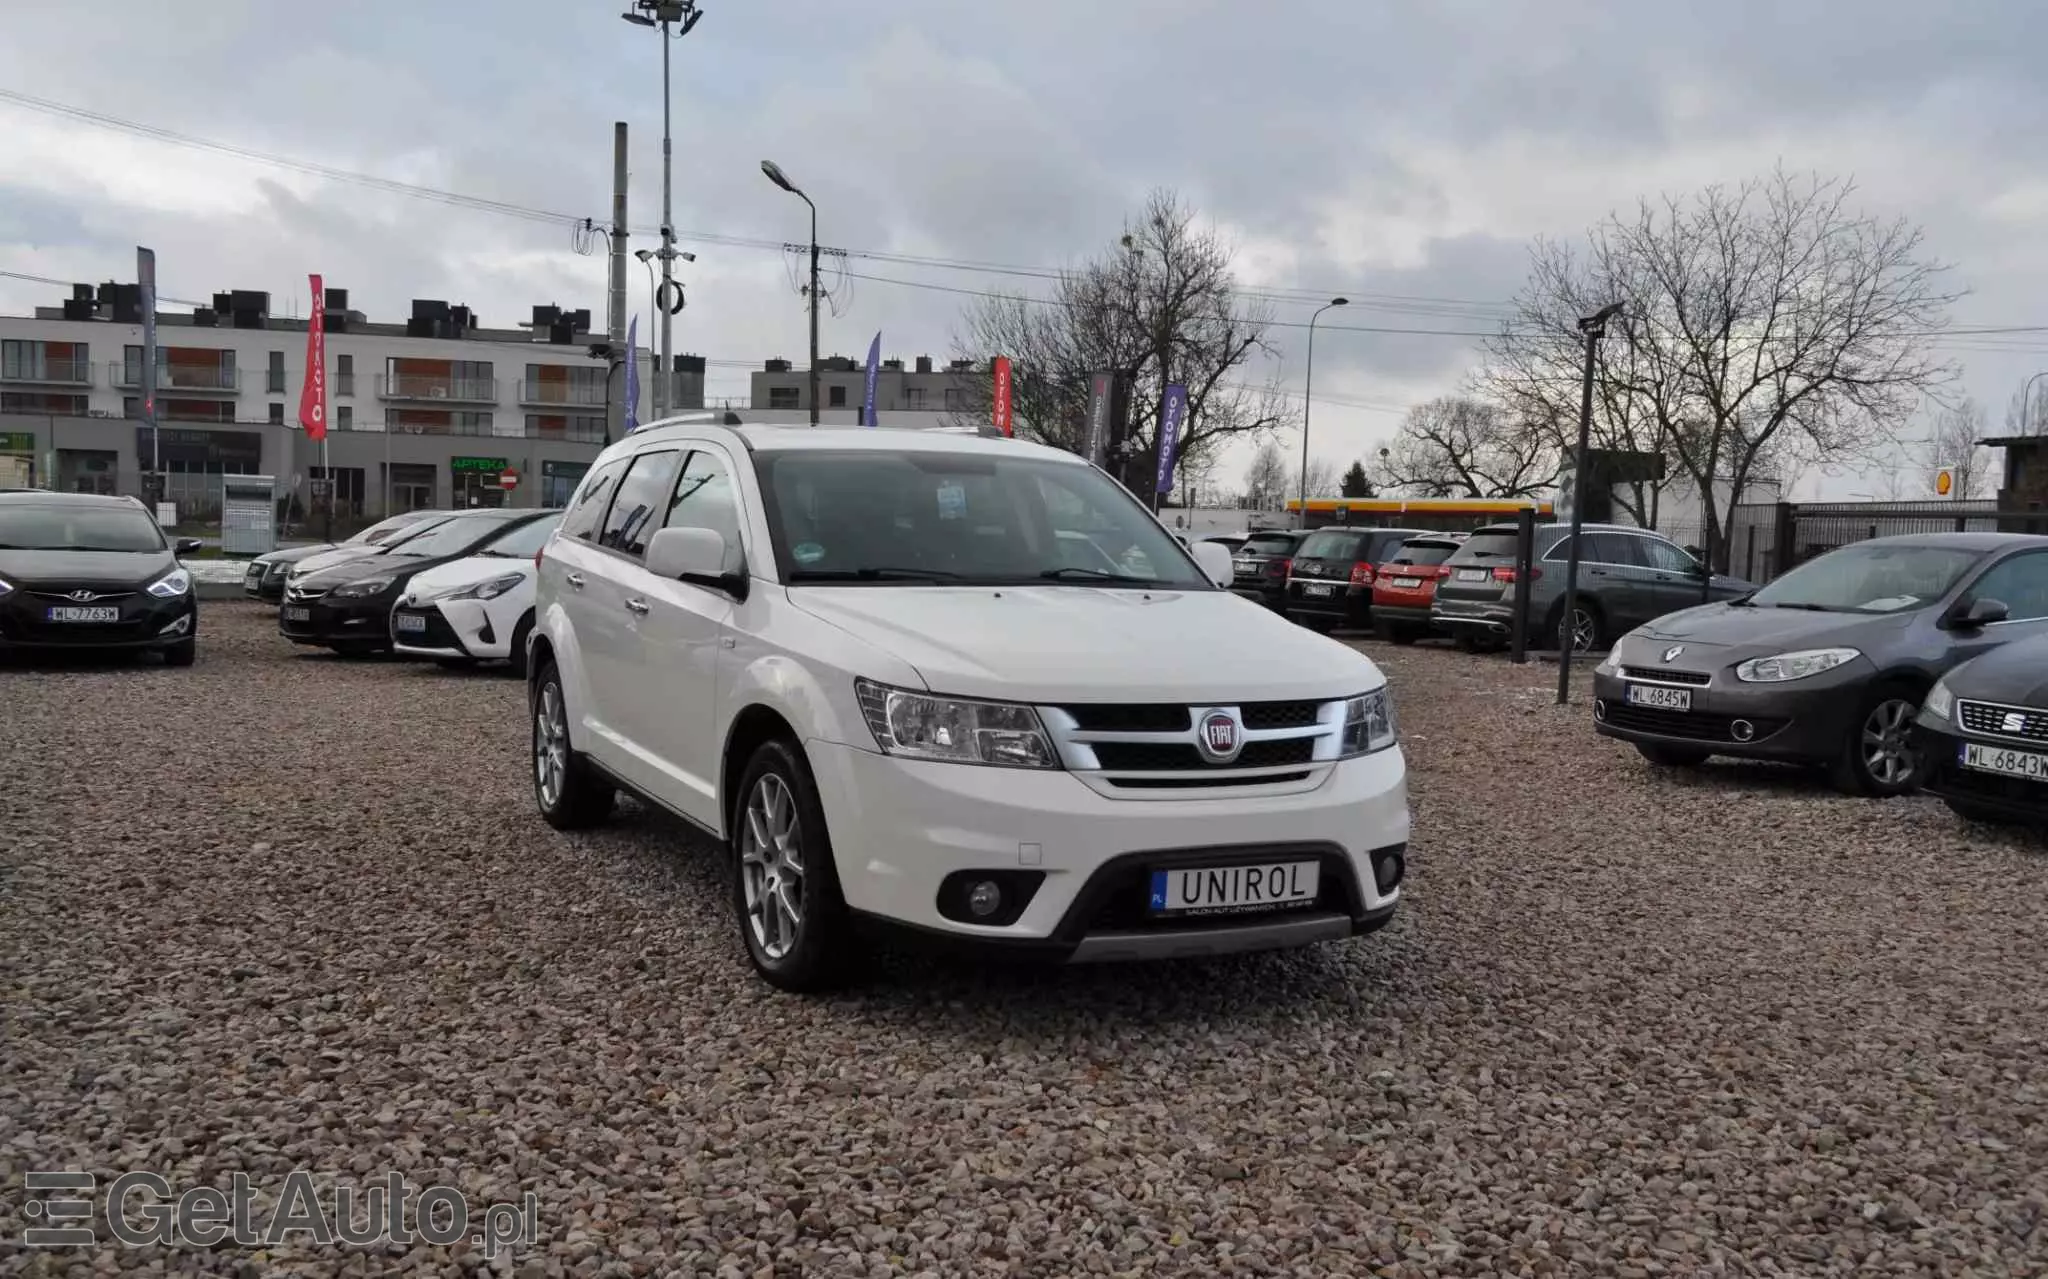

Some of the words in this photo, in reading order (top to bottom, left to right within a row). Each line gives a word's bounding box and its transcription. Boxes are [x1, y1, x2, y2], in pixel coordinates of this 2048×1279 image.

[996, 372, 1005, 426] OTOM
[1158, 396, 1178, 481] OTOMOTO
[453, 458, 505, 470] APTEKA
[1632, 686, 1647, 703] WL
[1650, 688, 1689, 709] 6845W
[1210, 725, 1231, 745] FIAT
[1968, 745, 1988, 767] WL
[1182, 864, 1306, 905] UNIROL
